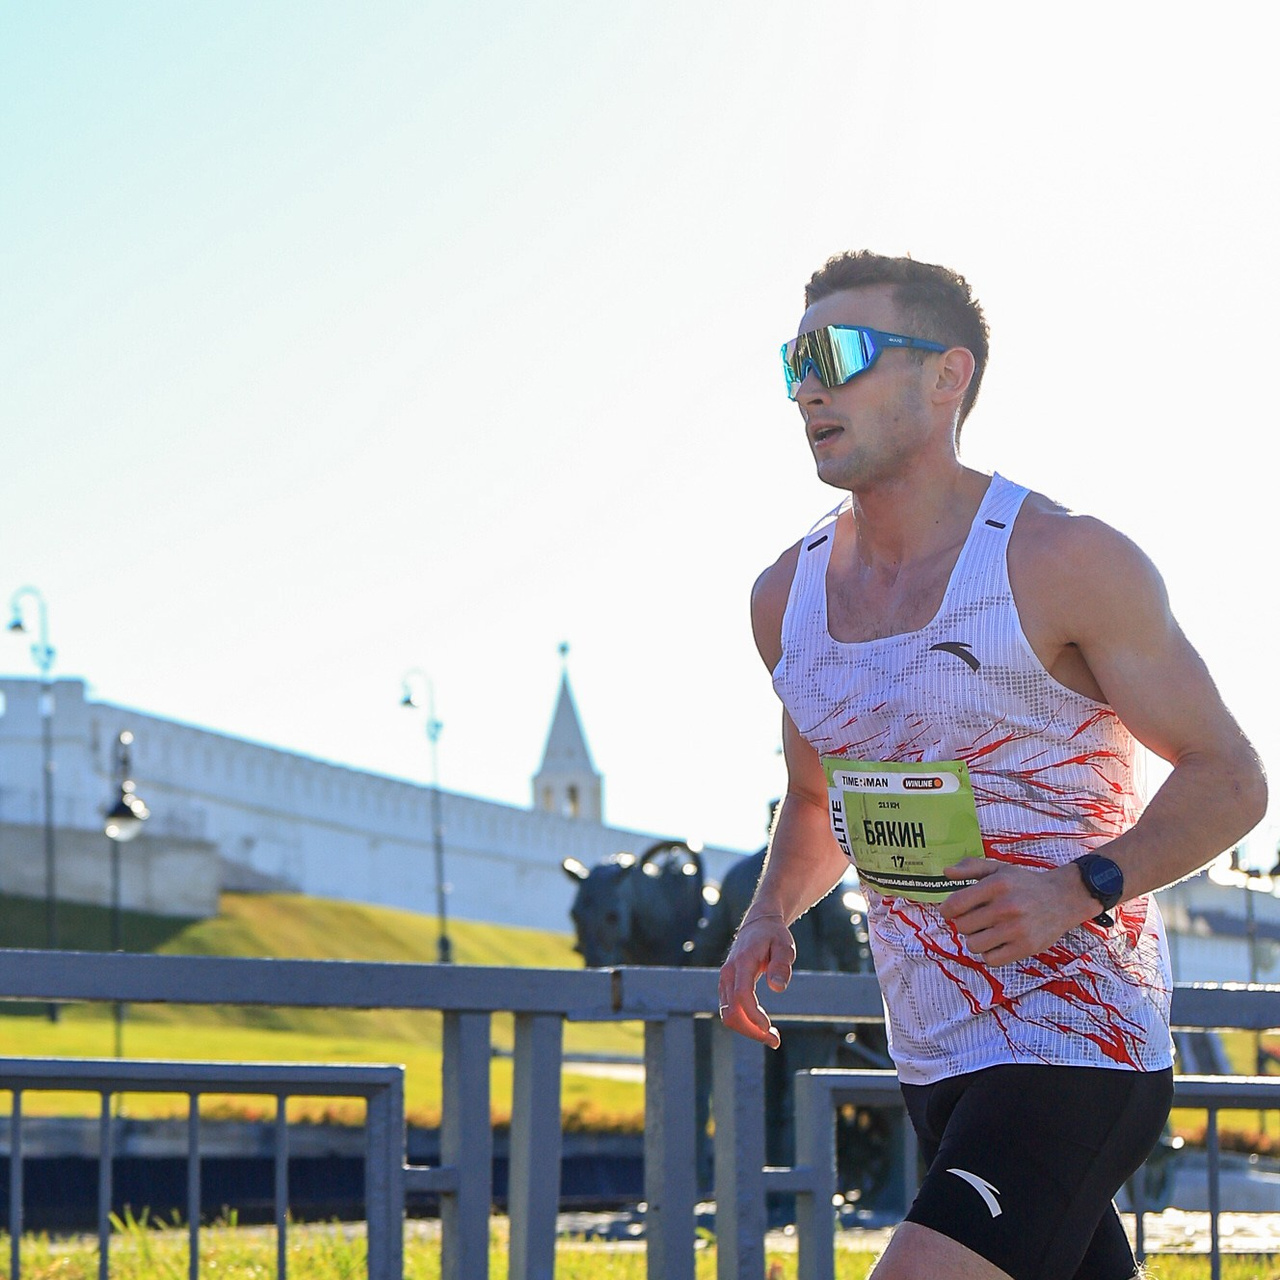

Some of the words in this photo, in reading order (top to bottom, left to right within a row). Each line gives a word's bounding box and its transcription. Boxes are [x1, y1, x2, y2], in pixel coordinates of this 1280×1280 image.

[905, 779, 933, 788] WINLINE
[831, 800, 852, 857] ELITE
[863, 819, 926, 849] БЯКИН
[891, 855, 905, 869] 17
